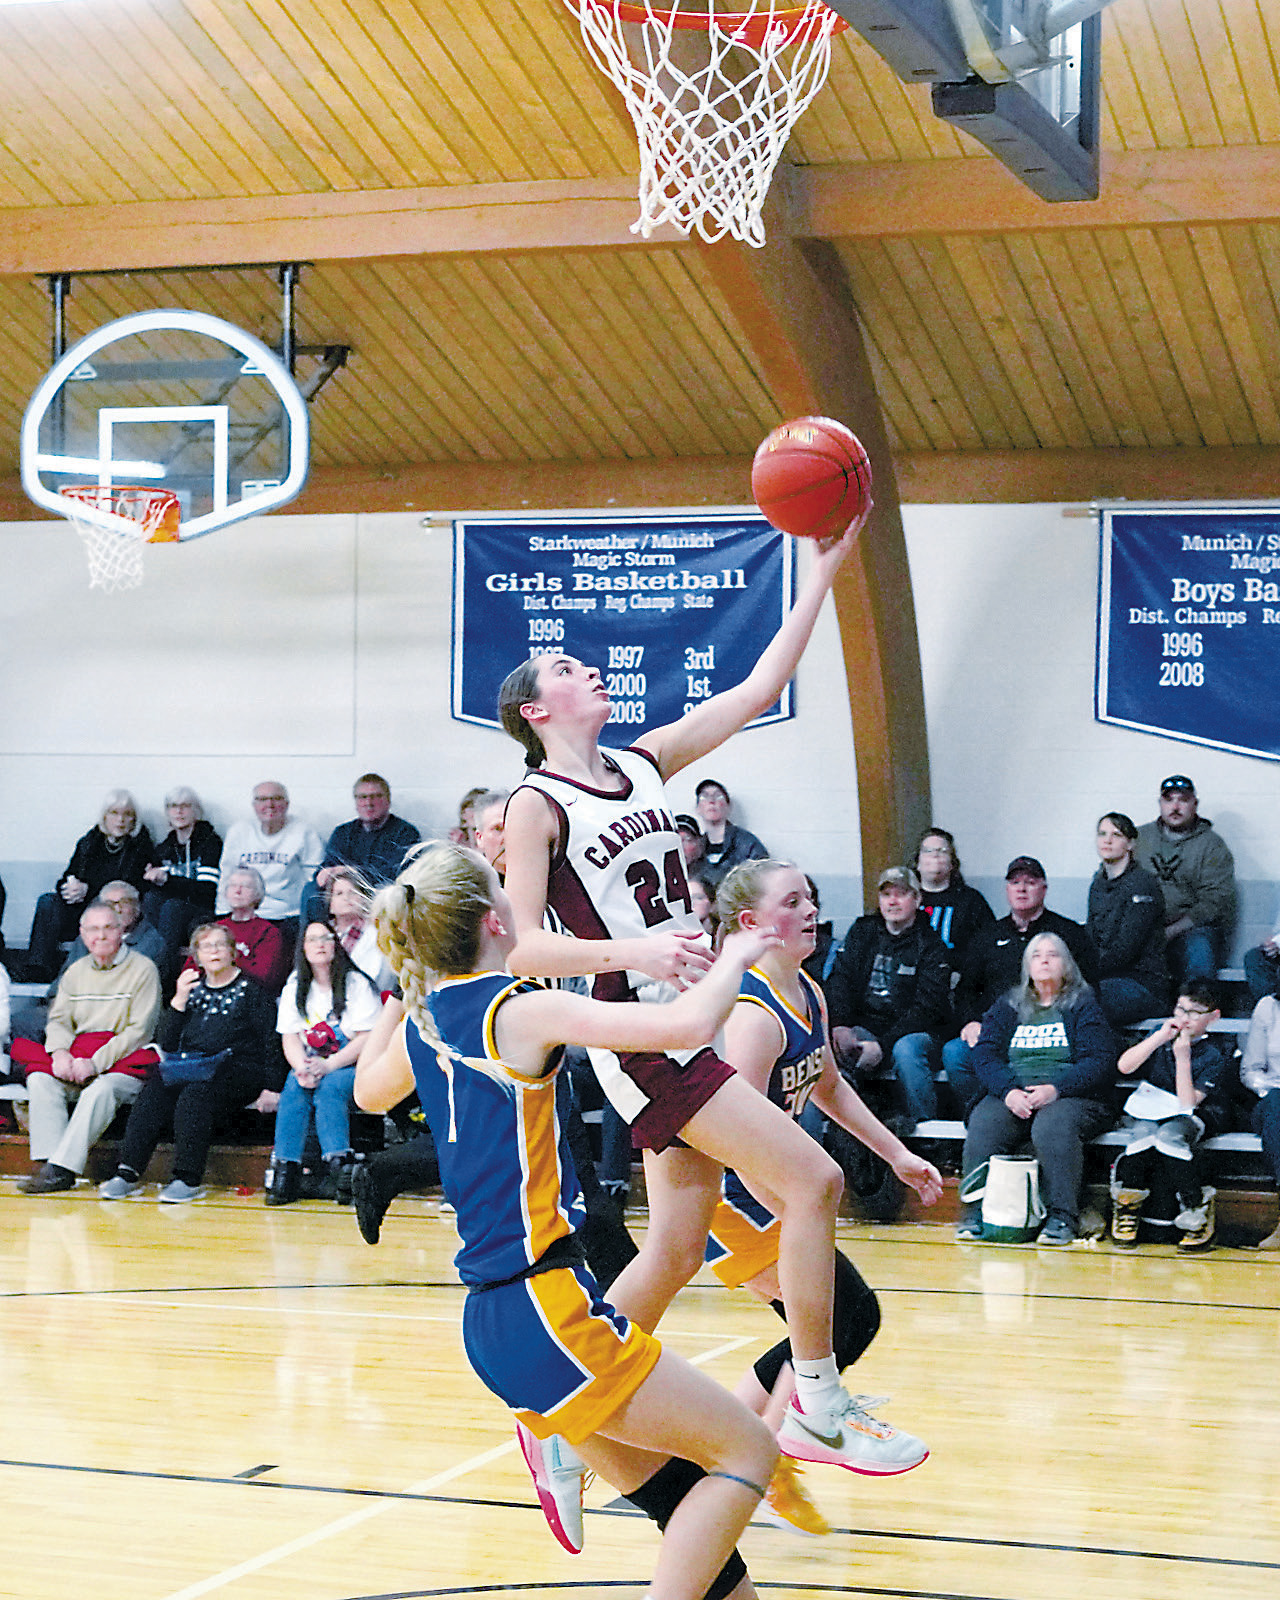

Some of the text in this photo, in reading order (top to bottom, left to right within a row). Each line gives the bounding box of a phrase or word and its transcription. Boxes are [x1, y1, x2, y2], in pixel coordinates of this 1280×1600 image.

[529, 534, 639, 551] Starkweather
[651, 532, 715, 549] Munich
[1181, 533, 1252, 551] Munich
[572, 551, 676, 570] Magic Storm
[486, 569, 748, 593] Girls Basketball
[1171, 577, 1235, 609] Boys
[523, 595, 549, 610] Dist.
[551, 594, 597, 614] Champs
[630, 593, 675, 613] Champs
[683, 593, 714, 609] State
[1128, 606, 1170, 624] Dist.
[1174, 606, 1247, 628] Champs
[528, 618, 565, 642] 1996
[1162, 632, 1204, 657] 1996
[608, 646, 644, 669] 1997
[684, 645, 715, 670] 3rd
[606, 673, 647, 697] 2000
[686, 675, 713, 698] 1st
[1159, 662, 1205, 687] 2008
[607, 701, 646, 725] 2003
[584, 807, 680, 871] CARDINA
[624, 848, 694, 929] 24
